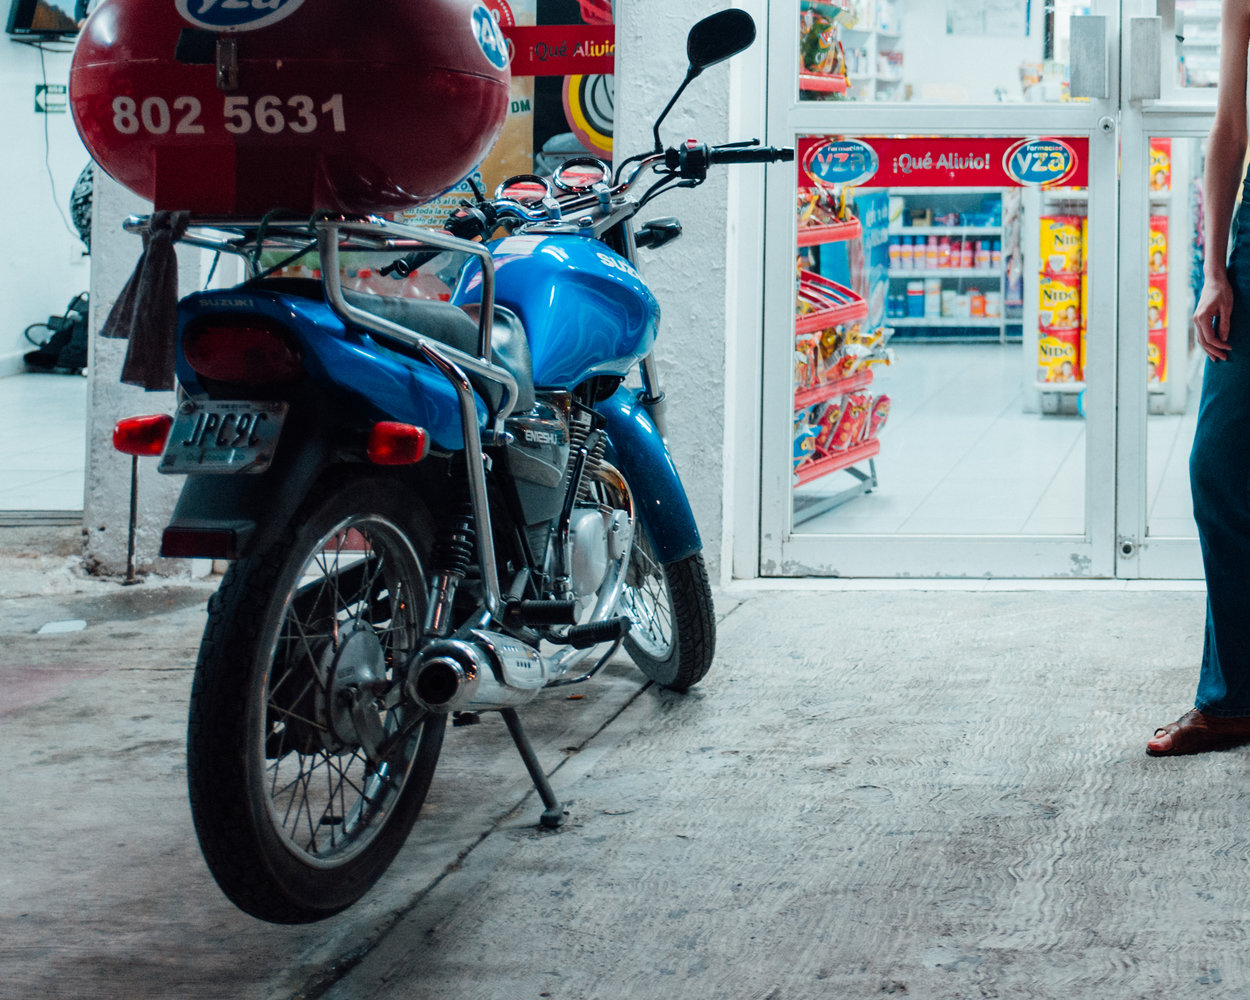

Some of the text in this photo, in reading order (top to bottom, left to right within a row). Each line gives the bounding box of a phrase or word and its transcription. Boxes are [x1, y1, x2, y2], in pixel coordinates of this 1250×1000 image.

[111, 93, 347, 135] 802 5631
[892, 152, 933, 173] ¡Qué
[937, 152, 991, 170] Alivio!
[1016, 152, 1066, 175] yza
[1043, 288, 1077, 301] NIDO
[199, 298, 253, 307] SUZUKI
[1040, 344, 1073, 356] NIDO
